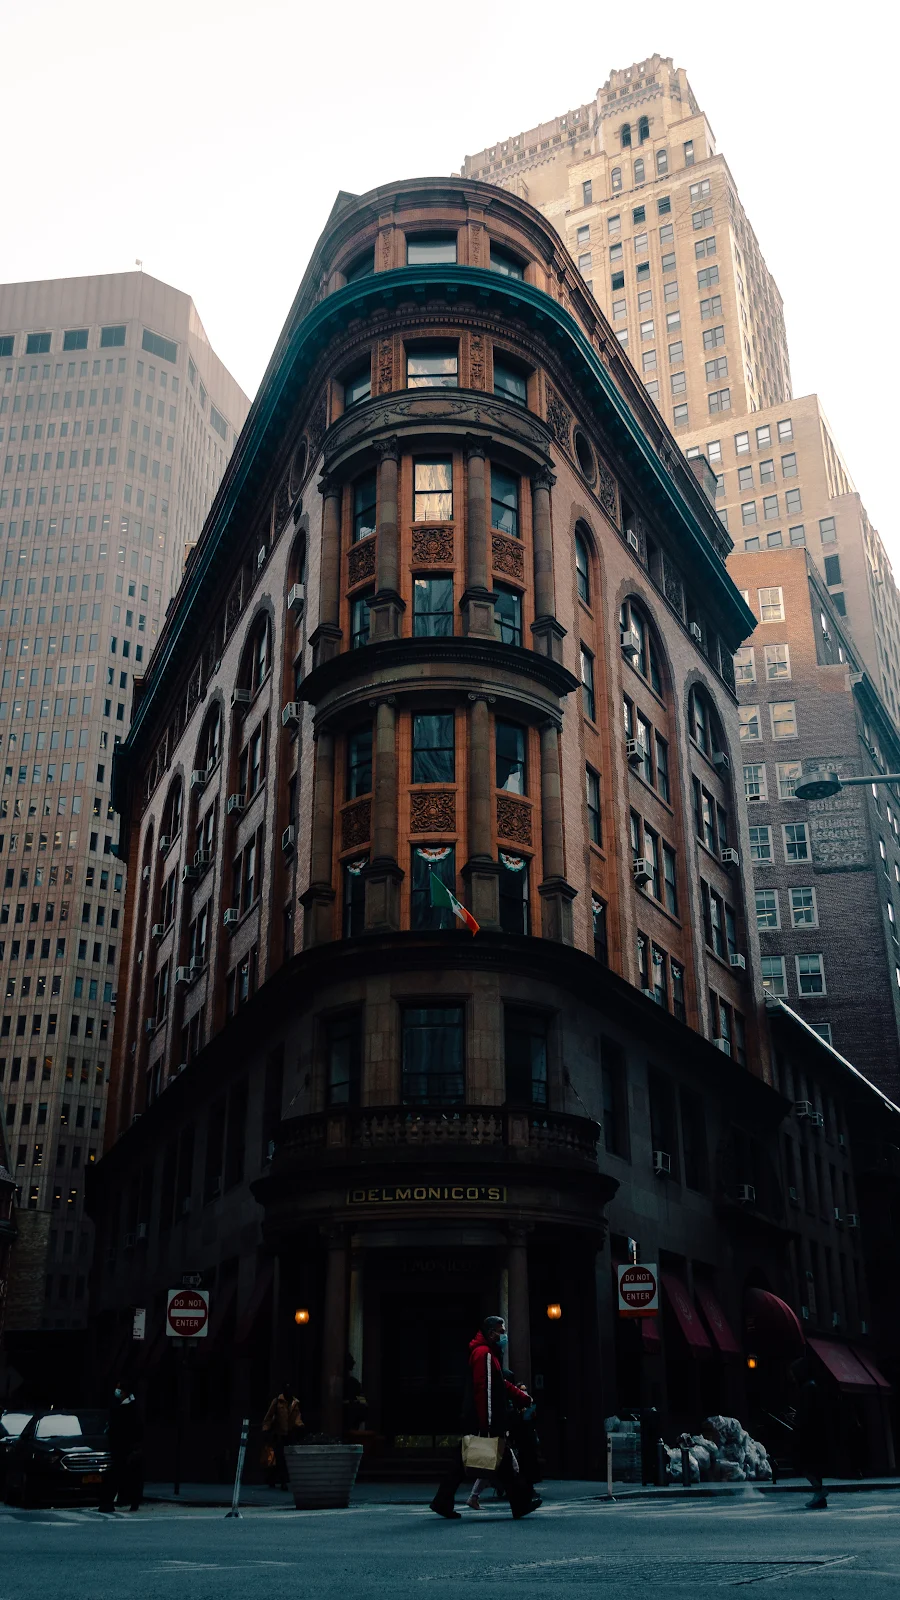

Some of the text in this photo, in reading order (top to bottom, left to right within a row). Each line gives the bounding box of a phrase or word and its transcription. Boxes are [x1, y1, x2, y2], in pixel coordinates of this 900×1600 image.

[353, 1187, 500, 1202] DELMONICO'S
[636, 1273, 650, 1281] NOT
[626, 1292, 650, 1300] ENTER
[174, 1299, 202, 1307] DO NOT
[175, 1319, 199, 1327] ENTER
